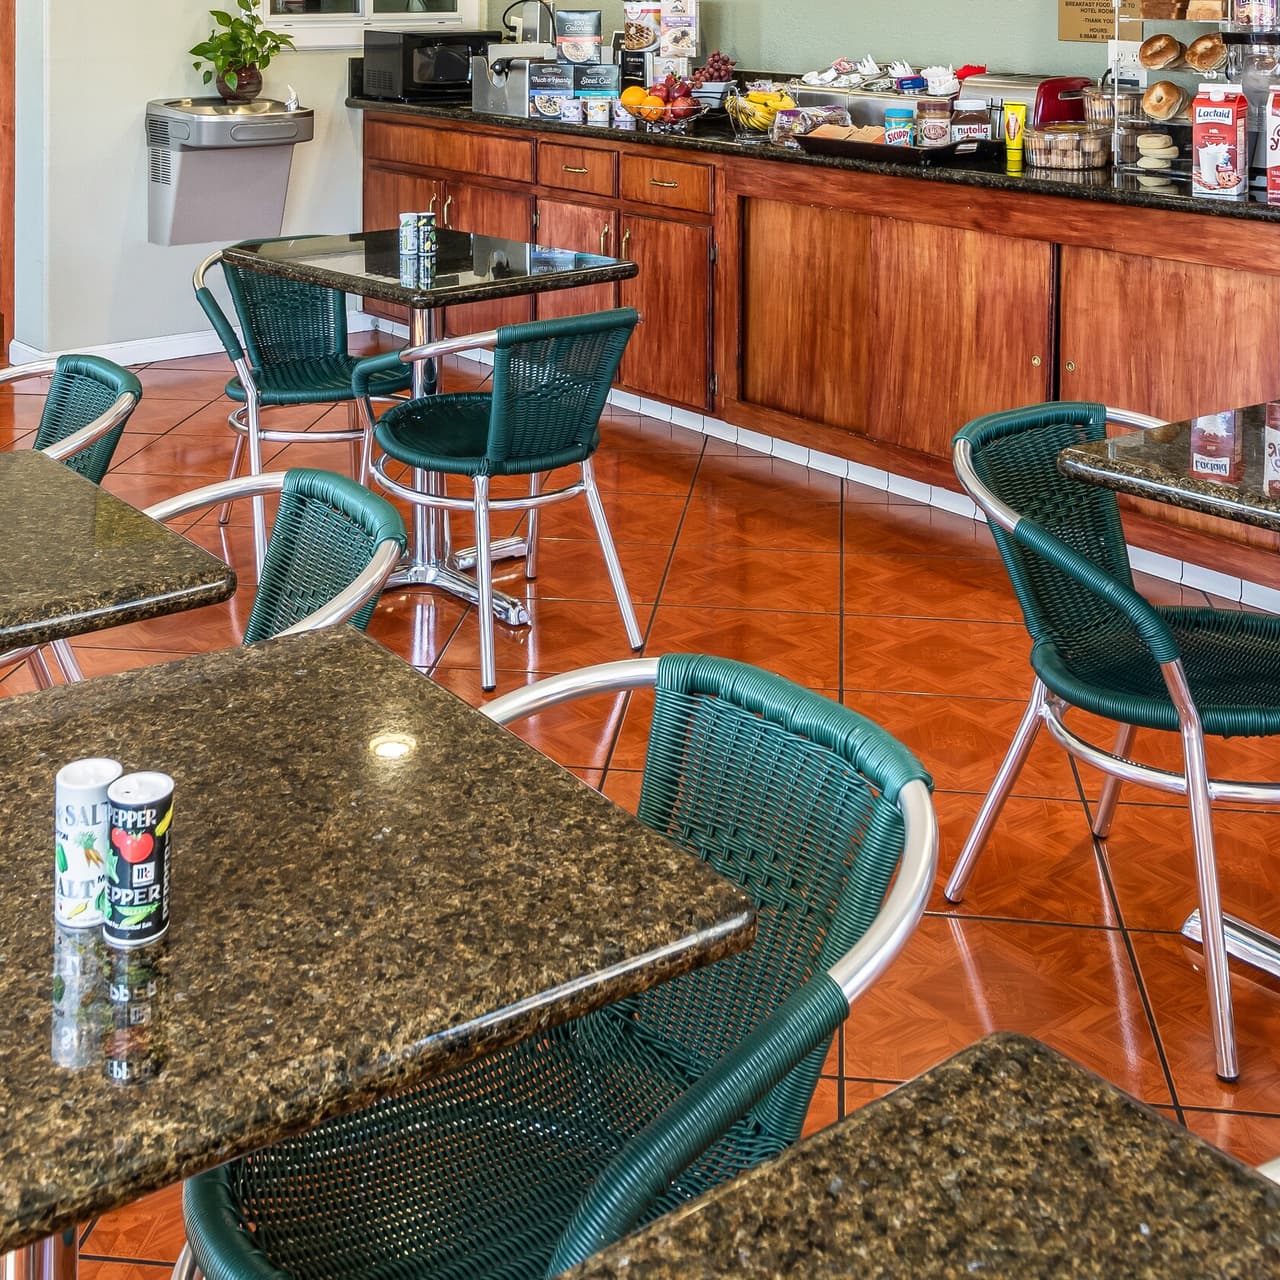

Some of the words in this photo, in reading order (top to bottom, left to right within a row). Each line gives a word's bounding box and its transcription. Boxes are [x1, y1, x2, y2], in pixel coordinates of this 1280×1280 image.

[599, 77, 612, 85] Cut
[1197, 108, 1231, 119] Lactaid
[957, 124, 989, 135] nutella
[887, 130, 910, 143] SKIPPY
